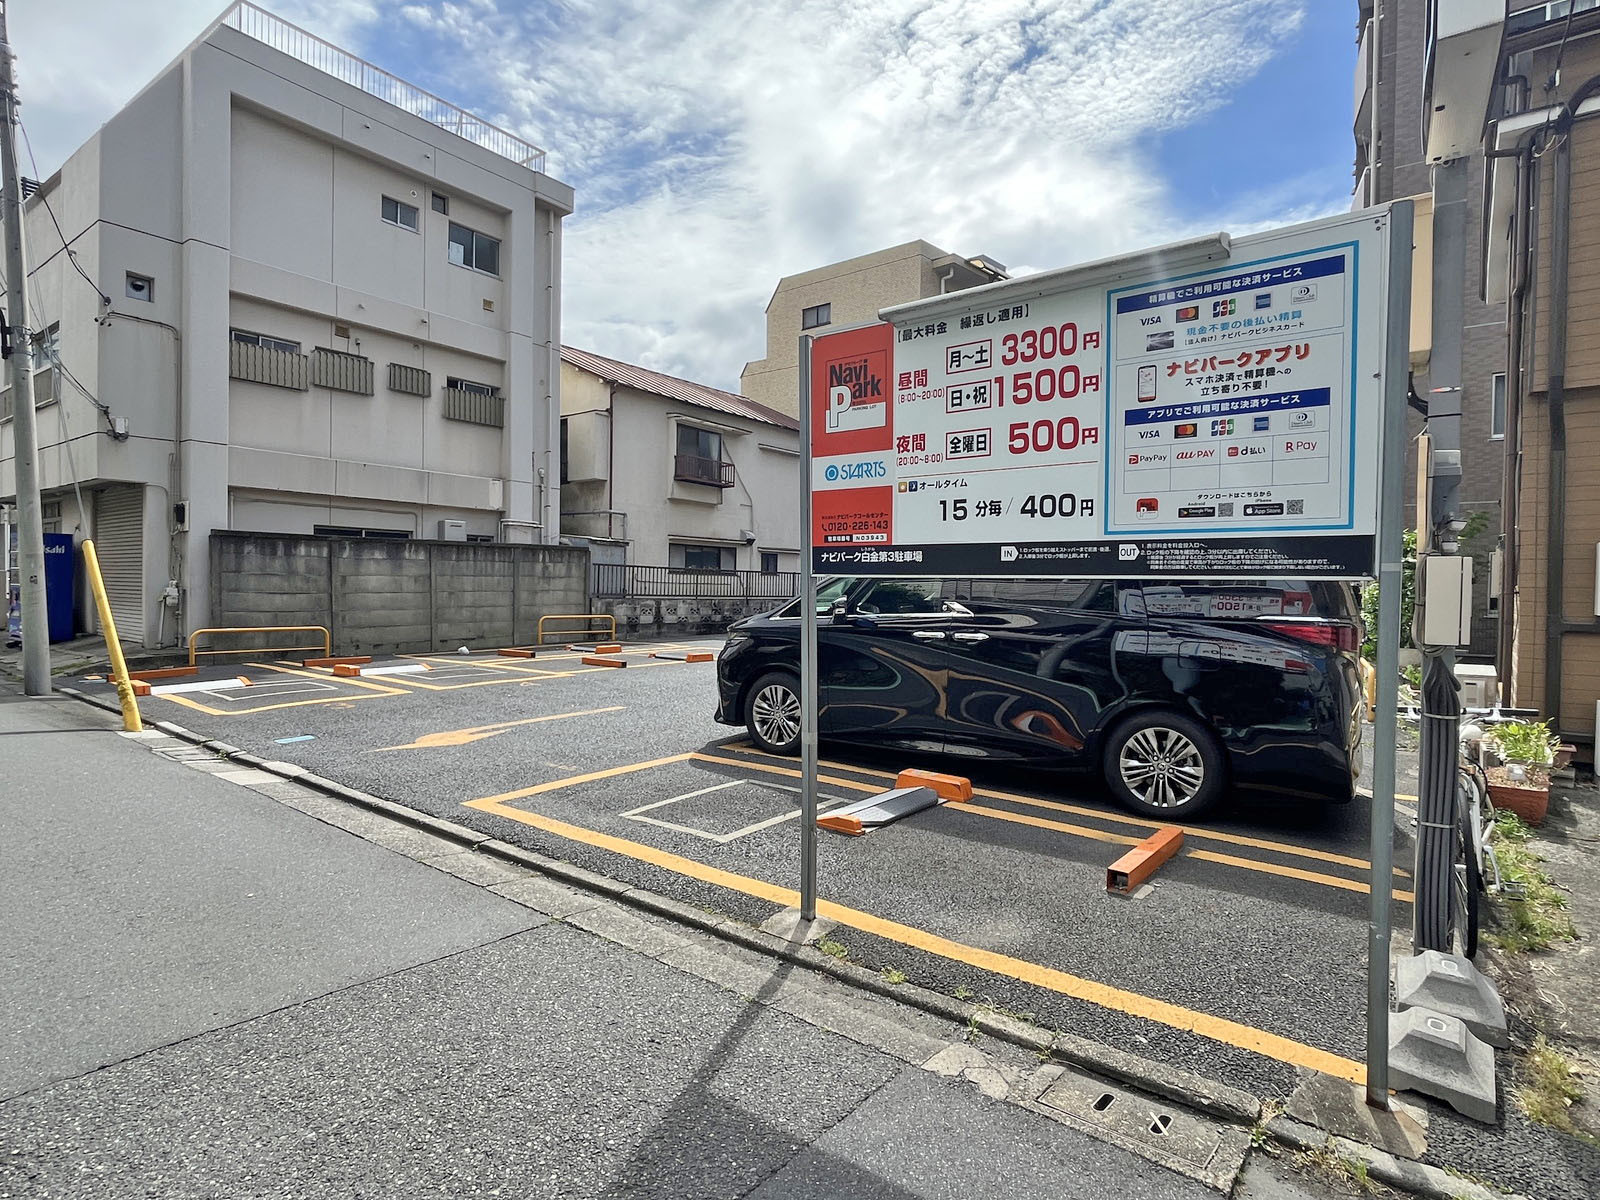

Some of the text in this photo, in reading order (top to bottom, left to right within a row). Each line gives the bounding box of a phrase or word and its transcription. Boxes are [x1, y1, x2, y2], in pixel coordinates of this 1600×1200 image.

[1149, 266, 1302, 304] 精算機でご利用可能な決済サービス
[1212, 299, 1236, 318] JCB
[1140, 315, 1162, 326] VISA
[1186, 310, 1303, 336] 現金不要の後払い精算
[1221, 321, 1305, 340] ナビパークビジネスカード
[1166, 343, 1311, 378] ナビパークアプリ
[829, 359, 868, 386] Navi
[898, 368, 928, 391] 昼間
[1185, 366, 1292, 387] スマホ決済で精算機への
[830, 375, 881, 429] Park
[1147, 394, 1301, 419] アプリでご利用可能な決済サービス
[1138, 430, 1160, 440] VISA
[1211, 418, 1235, 437] JCB
[896, 433, 926, 454] 夜間
[949, 433, 987, 454] 全曜日
[1240, 446, 1266, 456] d払い
[1296, 440, 1317, 452] Pay
[1140, 453, 1167, 462] PayPay
[1176, 449, 1216, 460] au PAY
[840, 461, 886, 480] STARTS
[919, 478, 968, 490] オールタイム
[1197, 491, 1272, 500] ダウンロードはこちらから
[939, 498, 967, 521] 15
[45, 545, 65, 554] sahi
[820, 550, 923, 562] ナビパーク白金第3駐車場
[1120, 548, 1137, 557] OUT
